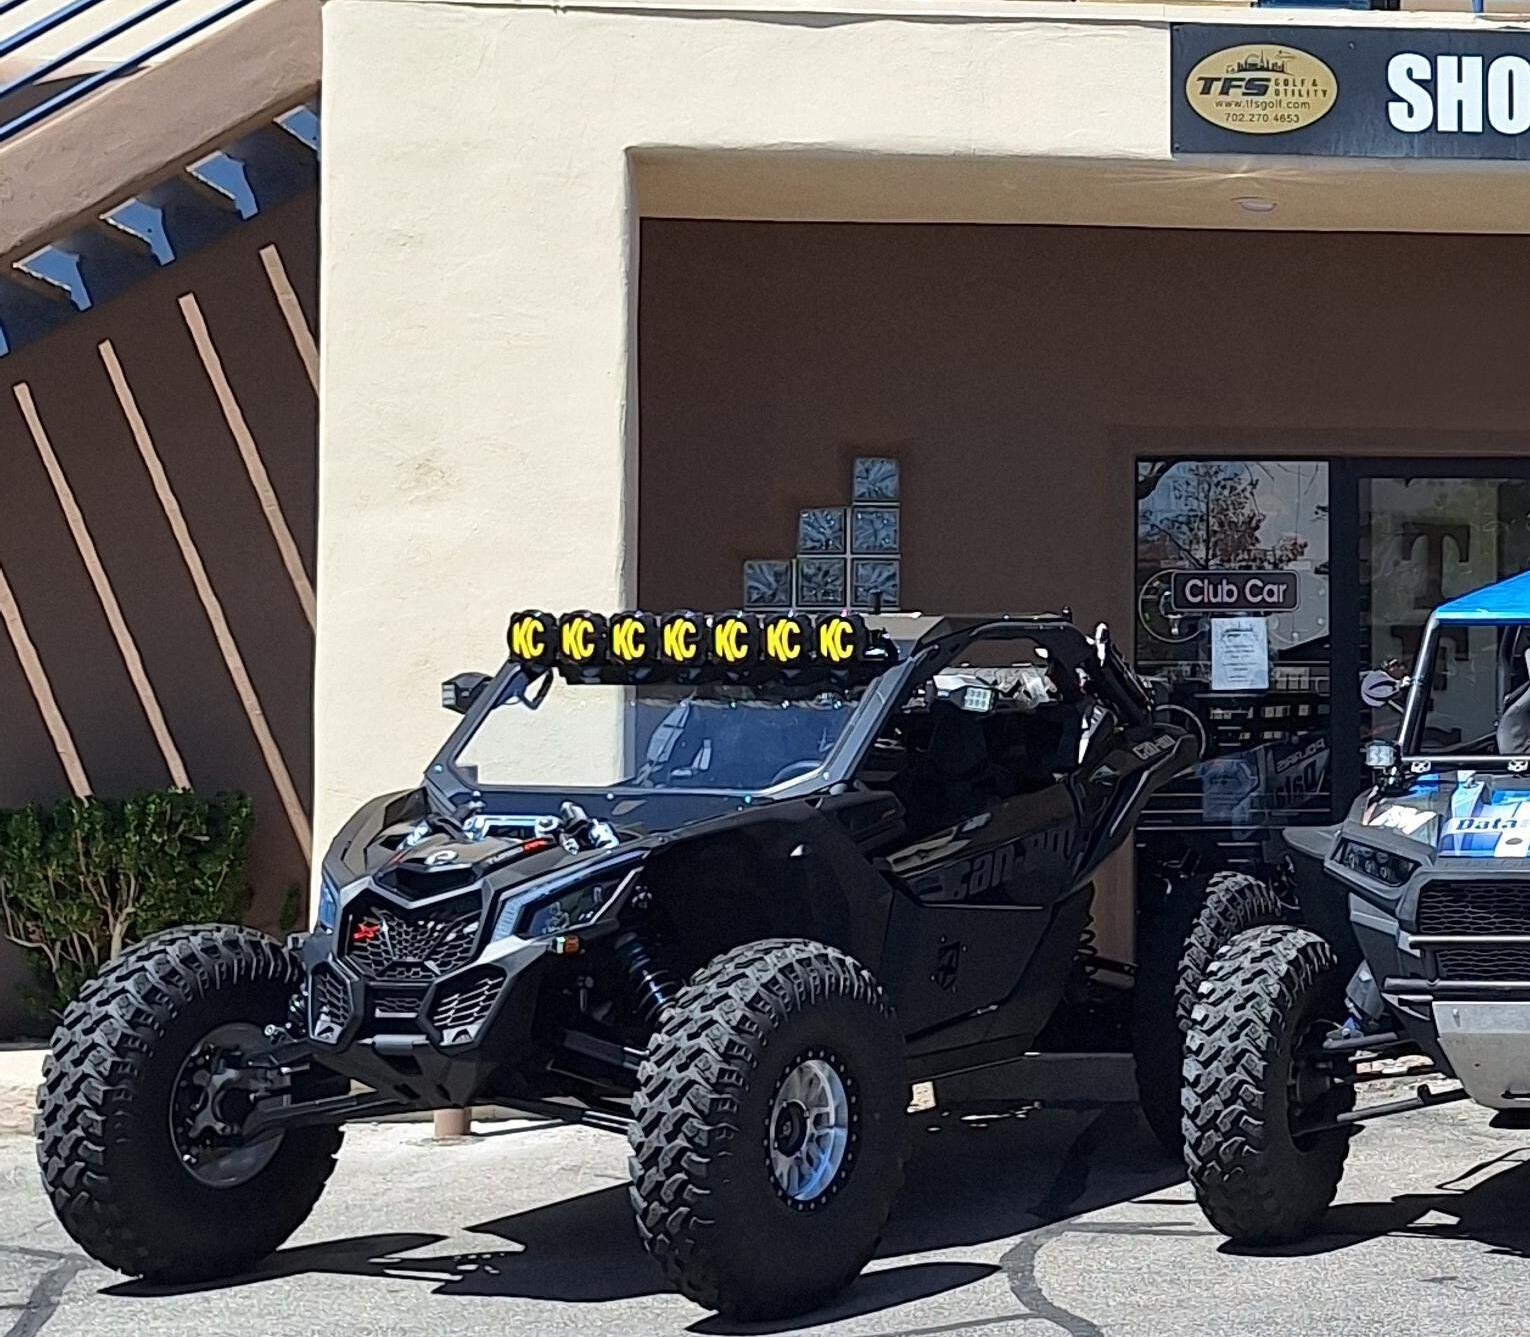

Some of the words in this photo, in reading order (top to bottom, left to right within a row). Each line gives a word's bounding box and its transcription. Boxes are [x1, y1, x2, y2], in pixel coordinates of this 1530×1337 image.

[1197, 77, 1272, 97] TFS
[1274, 78, 1305, 88] GOLF
[1274, 89, 1328, 98] UTILITY
[1215, 99, 1311, 111] www.tfsgolf.com
[1184, 578, 1238, 603] Club
[1244, 578, 1288, 604] Car
[513, 618, 543, 658] KC
[563, 618, 594, 657] KC
[614, 619, 644, 660] KC
[664, 619, 696, 661] KC
[716, 619, 747, 661] KC
[768, 619, 798, 661] KC
[821, 619, 852, 661] KC
